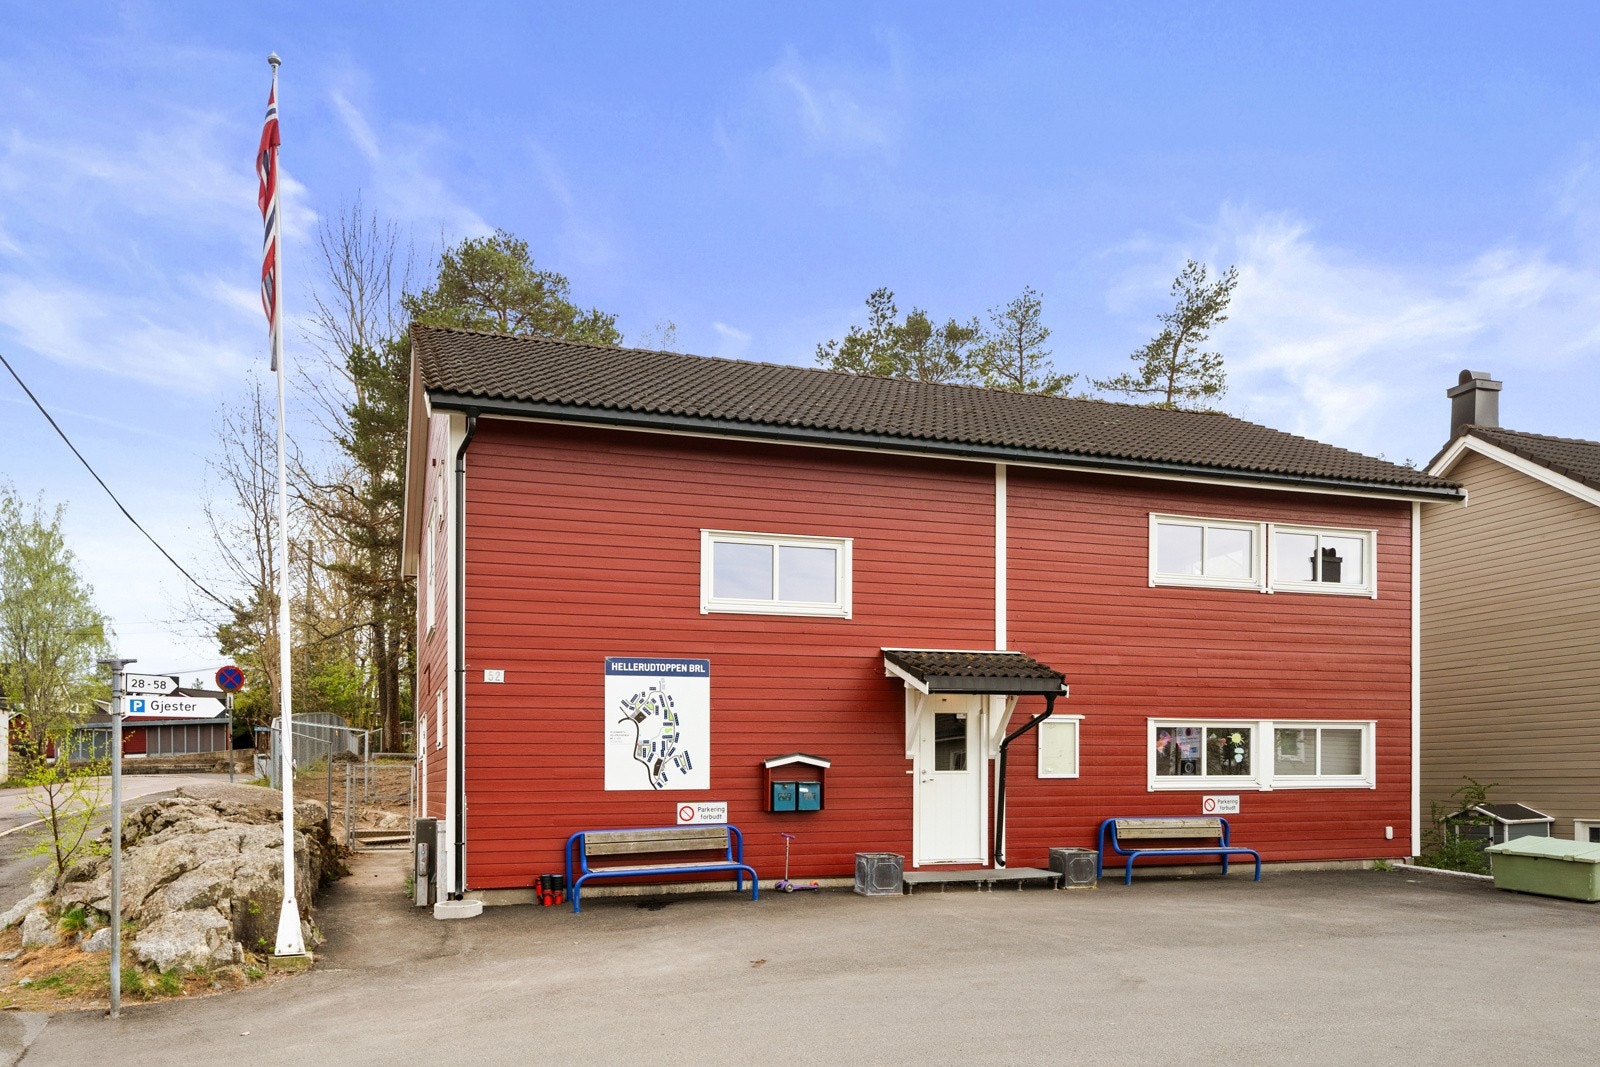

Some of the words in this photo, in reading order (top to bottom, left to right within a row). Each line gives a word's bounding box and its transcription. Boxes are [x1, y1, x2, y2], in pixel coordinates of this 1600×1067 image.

[611, 662, 688, 673] HELLERUDTOPPEN
[689, 663, 706, 673] BRL
[488, 670, 501, 681] 52
[133, 700, 143, 712] P
[150, 700, 197, 713] Gjester
